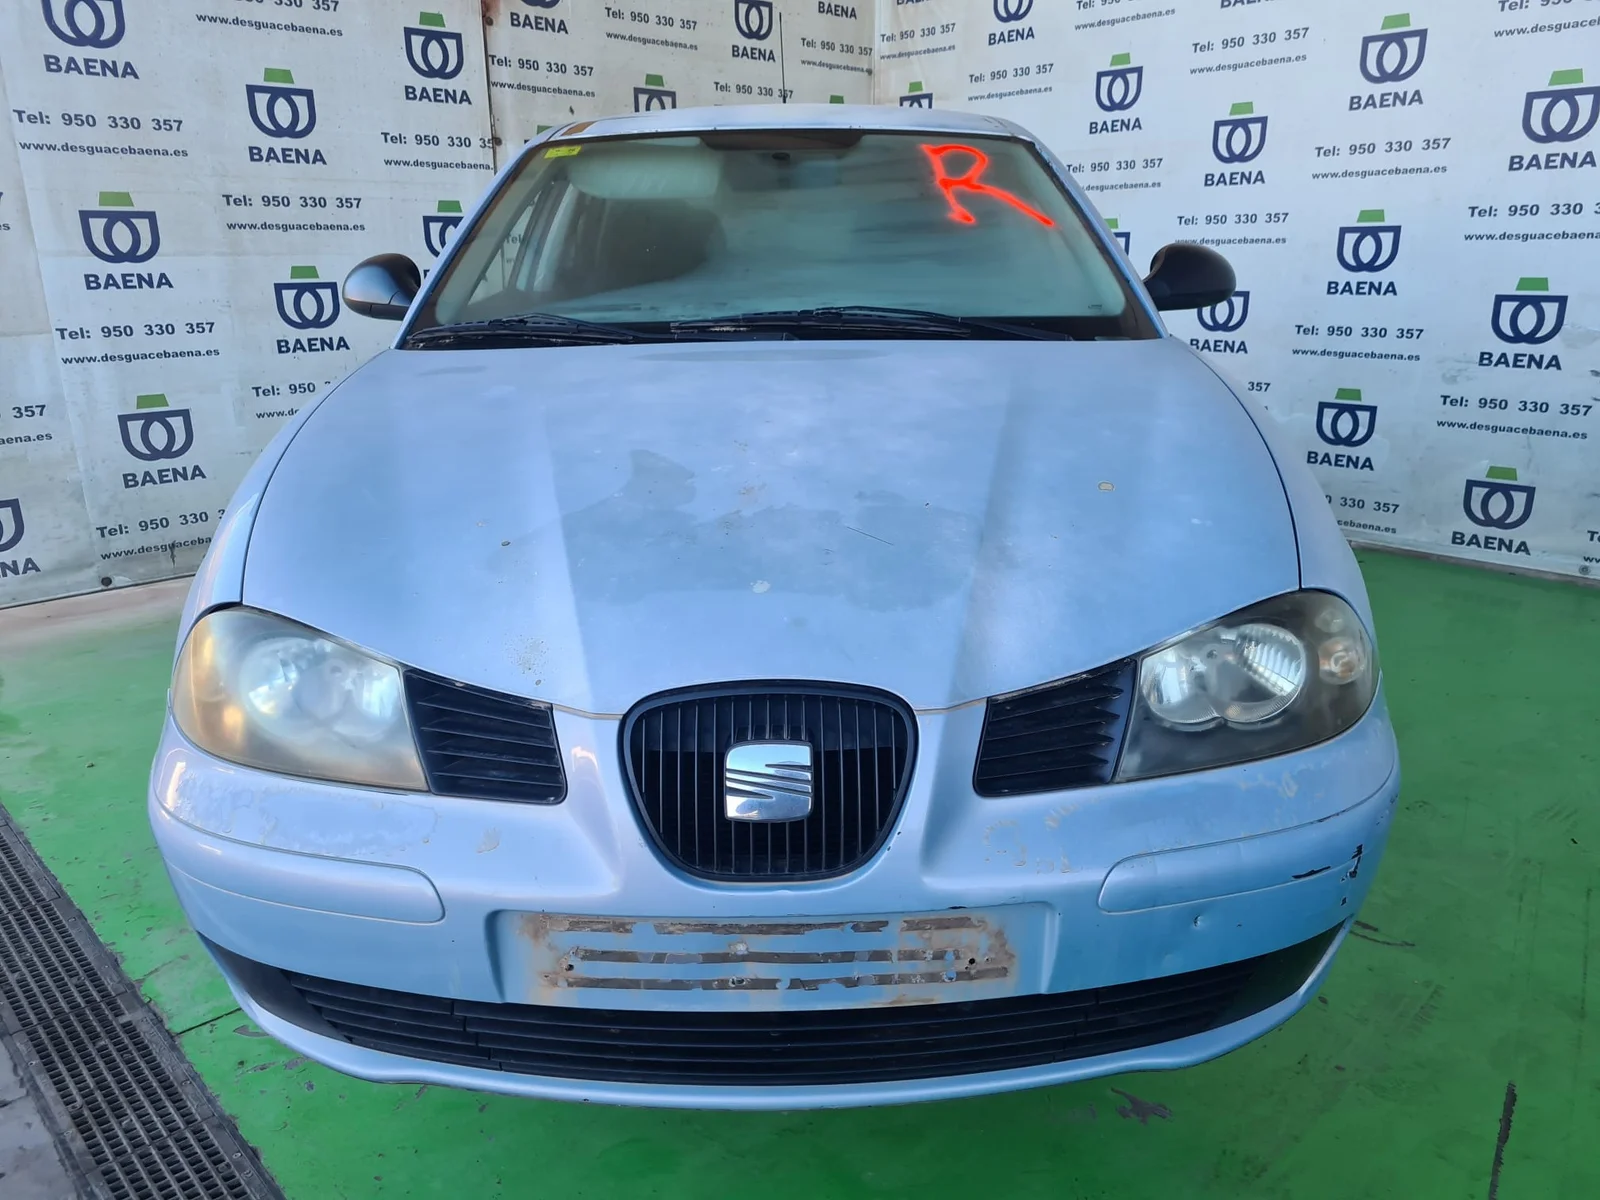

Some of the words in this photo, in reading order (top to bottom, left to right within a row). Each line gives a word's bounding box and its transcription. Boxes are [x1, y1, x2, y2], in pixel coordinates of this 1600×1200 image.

[313, 0, 339, 11] 357
[819, 1, 856, 19] BAENA
[1077, 0, 1094, 10] Tel:
[1499, 0, 1529, 11] Tel:
[196, 14, 342, 36] www.desguacebaena.es
[510, 12, 568, 34] BAENA
[605, 7, 624, 19] Tel:
[631, 11, 649, 23] 950
[656, 15, 674, 27] 330
[680, 19, 697, 30] 357
[1075, 9, 1175, 30] www.desguacebaena.es
[606, 32, 697, 50] www.desguacebaena.es
[881, 33, 896, 42] Tel:
[900, 30, 914, 40] 950
[921, 27, 935, 37] 330
[941, 23, 955, 34] 357
[989, 27, 1034, 45] BAENA
[1193, 41, 1213, 53] Tel:
[1222, 37, 1244, 49] 950
[1253, 32, 1276, 45] 330
[1285, 27, 1309, 40] 357
[732, 45, 775, 62] BAENA
[801, 38, 816, 48] Tel:
[821, 41, 835, 51] 950
[840, 44, 854, 54] 330
[859, 47, 872, 56] 357
[44, 55, 139, 79] BAENA
[489, 55, 511, 67] Tel:
[518, 59, 539, 70] 950
[547, 62, 566, 73] 330
[574, 65, 593, 76] 357
[969, 73, 984, 83] Tel:
[991, 70, 1007, 80] 950
[1013, 67, 1030, 77] 330
[1036, 63, 1053, 74] 357
[1190, 55, 1306, 74] www.desguacebaena.es
[405, 86, 472, 105] BAENA
[491, 81, 595, 97] www.desguacebaena.es
[714, 82, 730, 92] Tel:
[736, 84, 752, 94] 950
[758, 87, 773, 96] 330
[968, 87, 1052, 101] www.desguacebaena.es
[1349, 90, 1423, 111] BAENA
[13, 109, 50, 124] Tel:
[62, 113, 96, 127] 950
[108, 116, 140, 129] 330
[152, 119, 182, 131] 357
[1090, 118, 1141, 134] BAENA
[381, 132, 406, 144] Tel:
[415, 135, 439, 146] 950
[448, 136, 471, 147] 330
[479, 138, 494, 149] 35
[1315, 146, 1340, 157] Tel:
[1349, 143, 1375, 155] 950
[1385, 141, 1412, 152] 330
[1422, 138, 1451, 150] 357
[19, 143, 188, 157] www.desguacebaena.es
[249, 146, 327, 165] BAENA
[384, 159, 493, 170] www.desguacebaena.
[1067, 164, 1084, 173] Tel:
[1091, 162, 1109, 172] 950
[1116, 160, 1135, 170] 330
[1143, 158, 1163, 168] 357
[1509, 151, 1596, 171] BAENA
[1204, 171, 1265, 186] BAENA
[1312, 166, 1447, 179] www.desguacebaena.es
[921, 144, 1056, 227] R
[222, 195, 252, 206] Tel:
[262, 196, 290, 207] 950
[300, 197, 326, 208] 330
[336, 198, 361, 208] 357
[1469, 206, 1497, 217] Tel:
[1509, 205, 1539, 216] 950
[1551, 203, 1583, 215] 330
[227, 222, 365, 232] www.desguacebaena.es
[1177, 216, 1198, 225] Tel:
[1206, 215, 1227, 224] 950
[1235, 214, 1257, 224] 330
[1265, 213, 1289, 223] 357
[84, 273, 173, 290] BAENA
[1327, 281, 1397, 295] BAENA
[55, 328, 90, 339] Tel:
[101, 326, 133, 337] 950
[144, 324, 175, 335] 330
[186, 322, 214, 333] 357
[1295, 325, 1318, 335] Tel:
[1328, 326, 1352, 336] 950
[1362, 327, 1387, 338] 330
[1397, 328, 1423, 339] 357
[277, 337, 350, 354] BAENA
[62, 350, 219, 364] www.desguacebaena.es
[1292, 349, 1420, 361] www.desguacebaena.es
[1479, 352, 1561, 370] BAENA
[252, 386, 280, 397] Tel:
[289, 383, 315, 394] 950
[1248, 382, 1270, 392] 357
[12, 405, 45, 418] 357
[1441, 395, 1468, 407] Tel:
[1479, 398, 1508, 410] 950
[1519, 401, 1549, 413] 330
[1560, 404, 1592, 416] 357
[1437, 421, 1587, 439] www.desguacebaena.es
[1307, 451, 1374, 471] BAENA
[123, 465, 206, 488] BAENA
[1340, 497, 1365, 509] 330
[1374, 502, 1399, 513] 357
[96, 524, 129, 538] Tel:
[139, 518, 169, 531] 950
[179, 512, 208, 525] 330
[1452, 531, 1530, 555] BAENA
